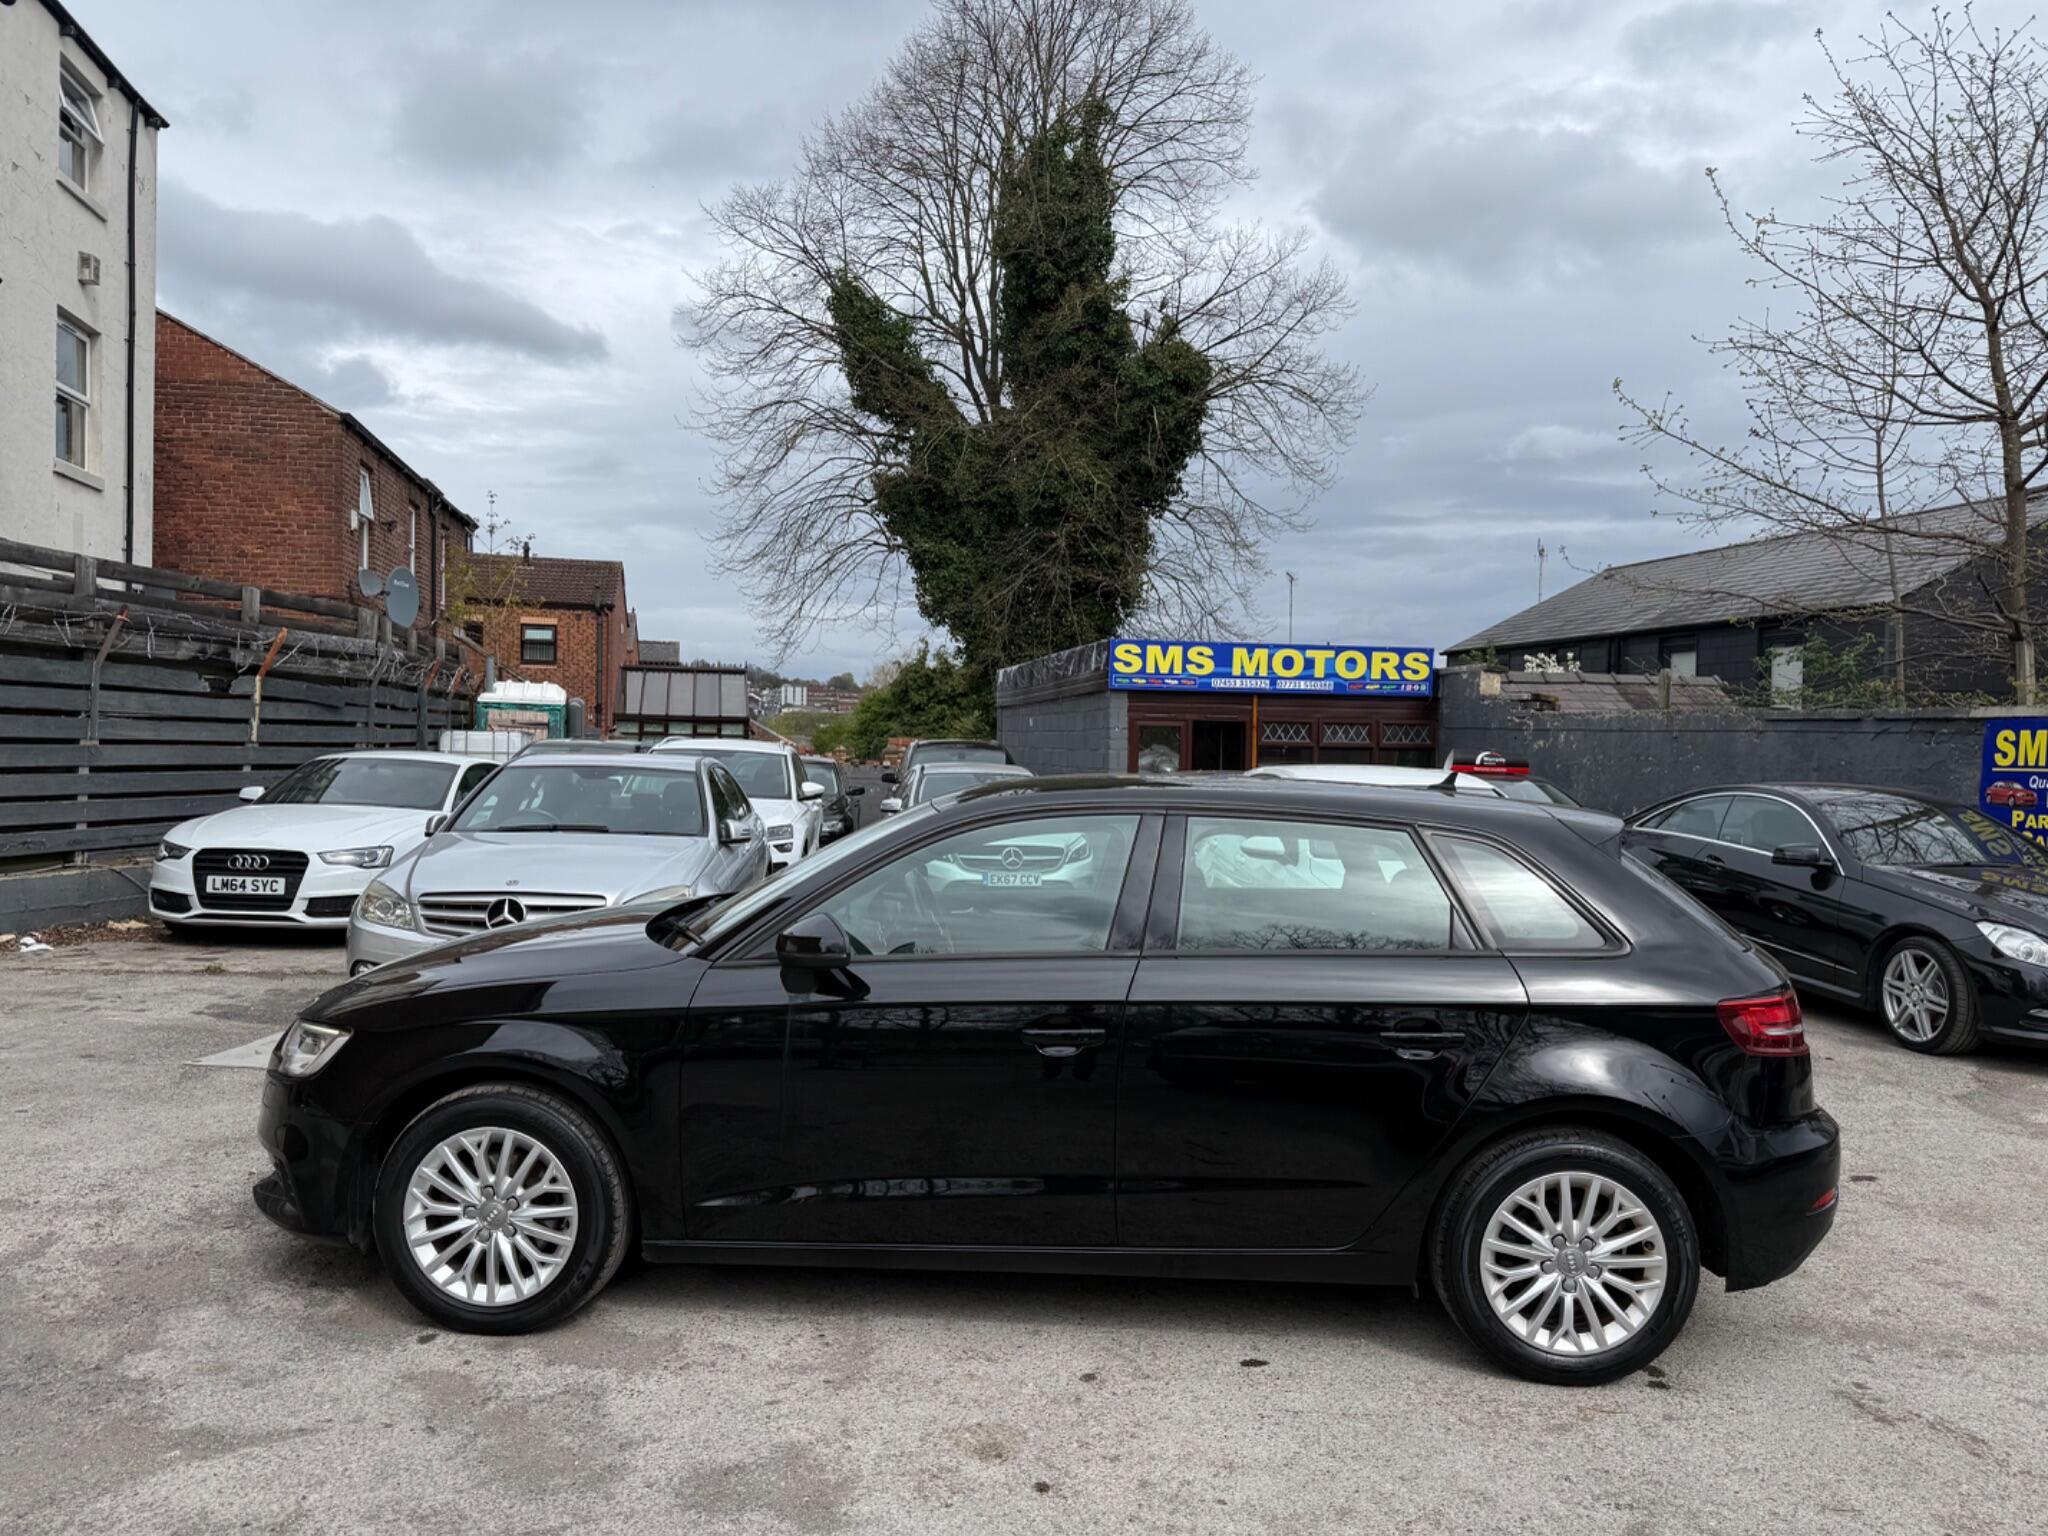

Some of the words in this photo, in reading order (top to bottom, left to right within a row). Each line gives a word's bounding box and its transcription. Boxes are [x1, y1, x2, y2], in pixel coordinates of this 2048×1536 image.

[1113, 643, 1216, 676] SMS
[1231, 647, 1431, 681] MOTORS
[1994, 729, 2048, 767] SM
[212, 877, 247, 892] LM64
[251, 879, 279, 893] SYC
[990, 874, 1018, 885] EK67
